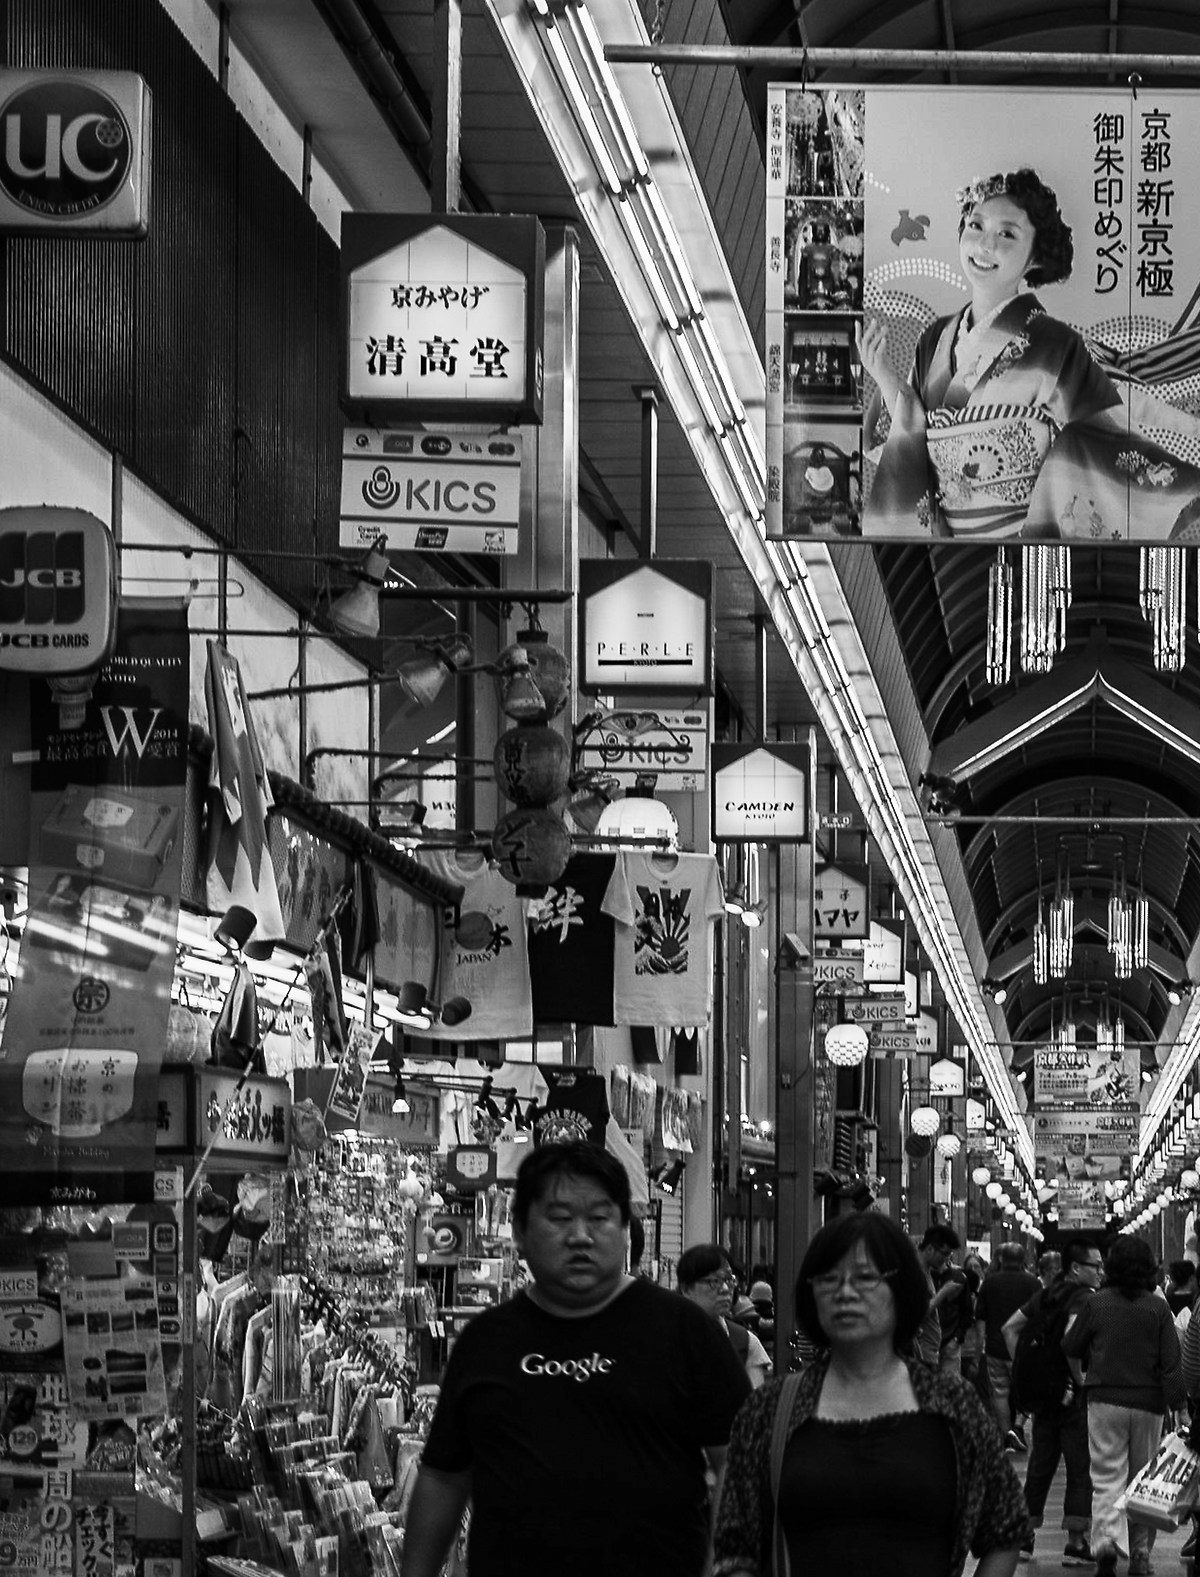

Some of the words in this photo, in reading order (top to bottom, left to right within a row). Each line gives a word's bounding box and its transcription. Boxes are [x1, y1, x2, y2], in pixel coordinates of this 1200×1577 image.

[1093, 112, 1128, 294] 御朱印めぐり
[390, 284, 491, 310] 京みやげ
[365, 334, 510, 379] 清高堂
[406, 479, 497, 514] KICS
[0, 569, 82, 588] JCB
[52, 633, 89, 648] CARDS
[153, 728, 179, 739] 2014
[725, 801, 795, 812] CAMDEN
[456, 952, 492, 967] JAPAN
[819, 966, 856, 980] KICS
[866, 1006, 898, 1019] KICS
[882, 1036, 910, 1048] KICS
[5, 1277, 36, 1292] KICS
[521, 1352, 613, 1383] Google
[40, 1373, 76, 1577] 地球一周の船
